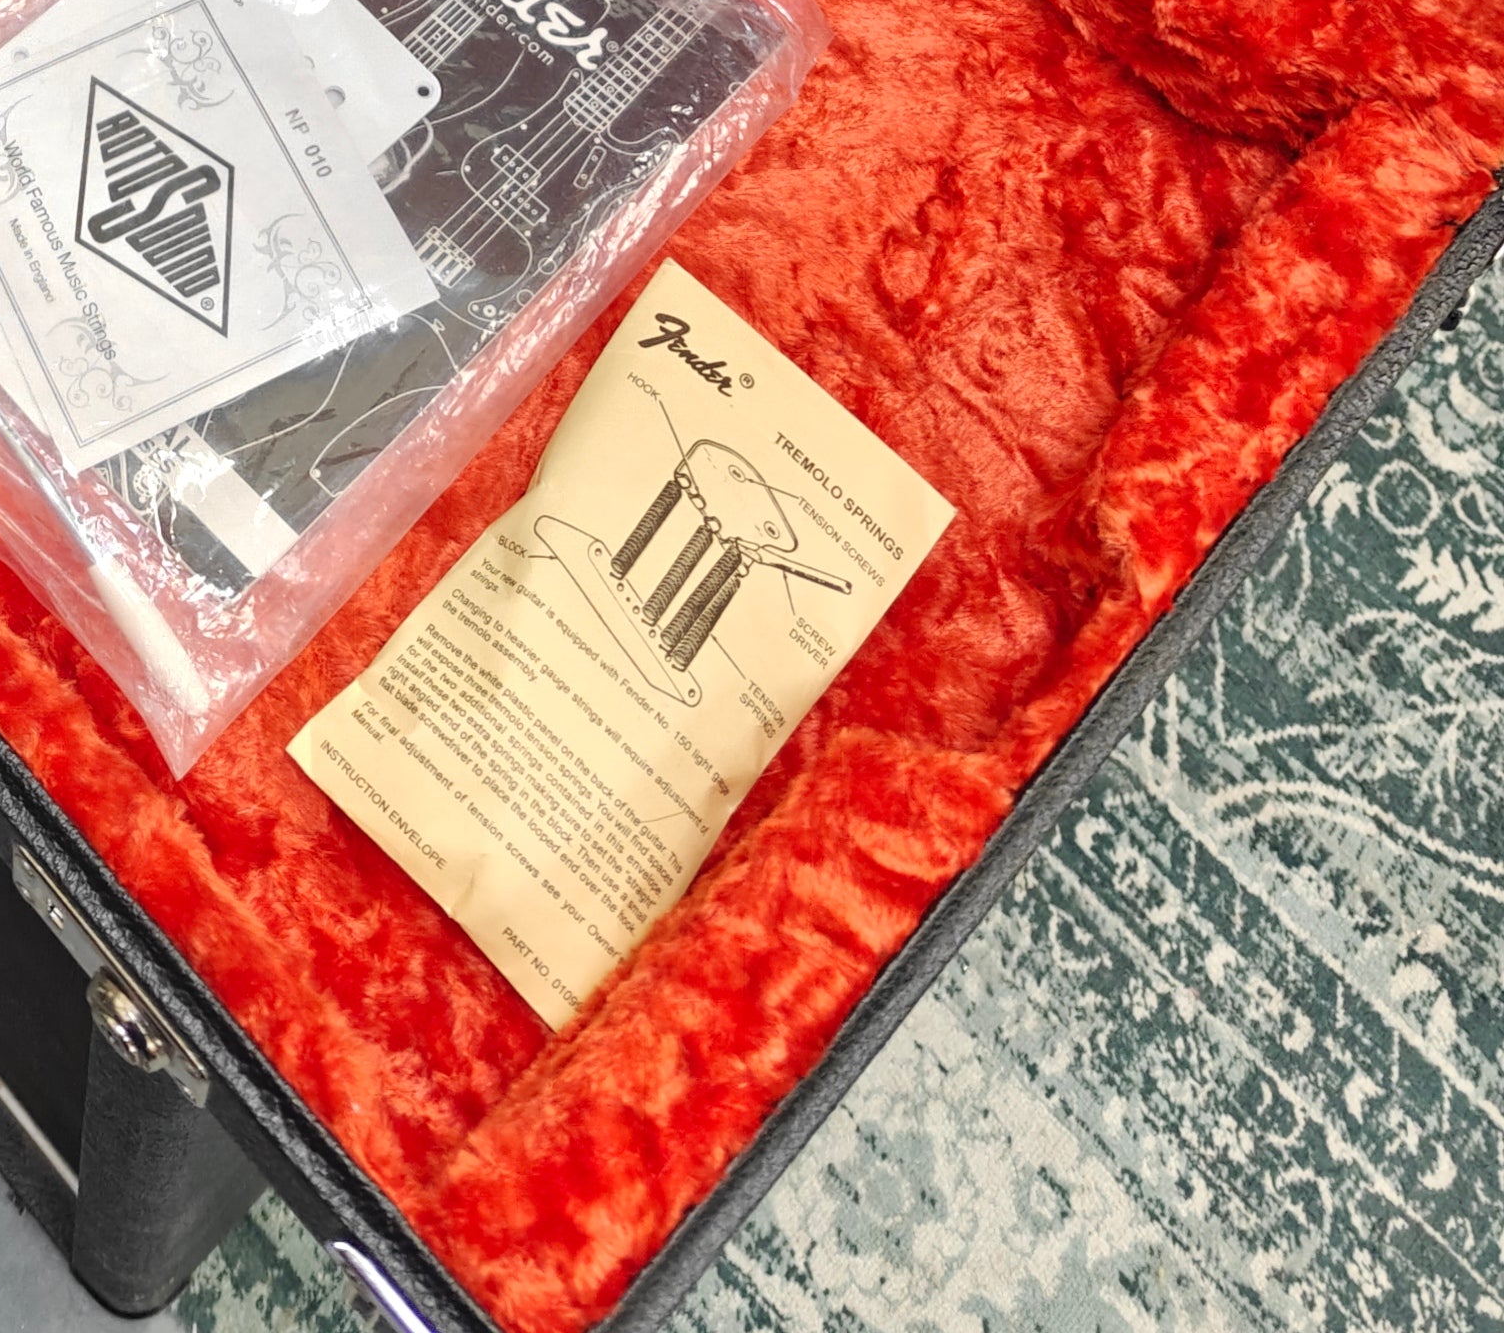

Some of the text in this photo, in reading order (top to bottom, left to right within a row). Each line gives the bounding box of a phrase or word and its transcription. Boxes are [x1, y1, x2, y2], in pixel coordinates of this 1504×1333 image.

[285, 108, 332, 178] NP 010
[3, 139, 116, 361] World Famous Music Strings
[627, 372, 661, 401] HOOK
[498, 534, 528, 558] BLOCK
[775, 432, 904, 561] TREMOLO SPRINGS
[798, 496, 885, 587] TENSION SCREWS
[457, 611, 492, 642] tremolo
[481, 557, 713, 773] Your new guitar equipped with Fender 150 light
[788, 628, 828, 670] DRIVER
[796, 617, 836, 657] SCREW
[387, 665, 409, 686] right
[408, 683, 441, 713] angled
[488, 759, 519, 792] spring
[546, 815, 573, 846] block.
[396, 654, 581, 832] Install these extra springs making sure
[416, 636, 434, 651] will
[431, 649, 464, 678] expose
[463, 674, 489, 698] three
[487, 693, 524, 731] tremolo
[524, 728, 559, 765] tension
[614, 819, 632, 838] will
[630, 834, 650, 856] find
[425, 623, 463, 658] Remove
[479, 667, 503, 690] white
[501, 688, 535, 721] plastic
[533, 718, 563, 747] panel
[590, 773, 614, 800] back
[452, 588, 703, 827] Changing heavier gauge strings will require adjustment
[739, 693, 776, 739] SPRINGS
[748, 680, 787, 729] TENSION
[320, 739, 447, 870] INSTRUCTION ENVELOPE
[361, 700, 379, 717] For
[379, 716, 401, 736] final
[399, 736, 454, 791] adjustment
[467, 801, 504, 841] tension
[505, 842, 540, 878] screws
[541, 879, 561, 900] see
[560, 899, 586, 924] your
[394, 689, 562, 854] blade screwdriver place looped
[459, 690, 625, 854] additional springs contained this
[502, 926, 533, 958] PART
[530, 956, 550, 981] NO.
